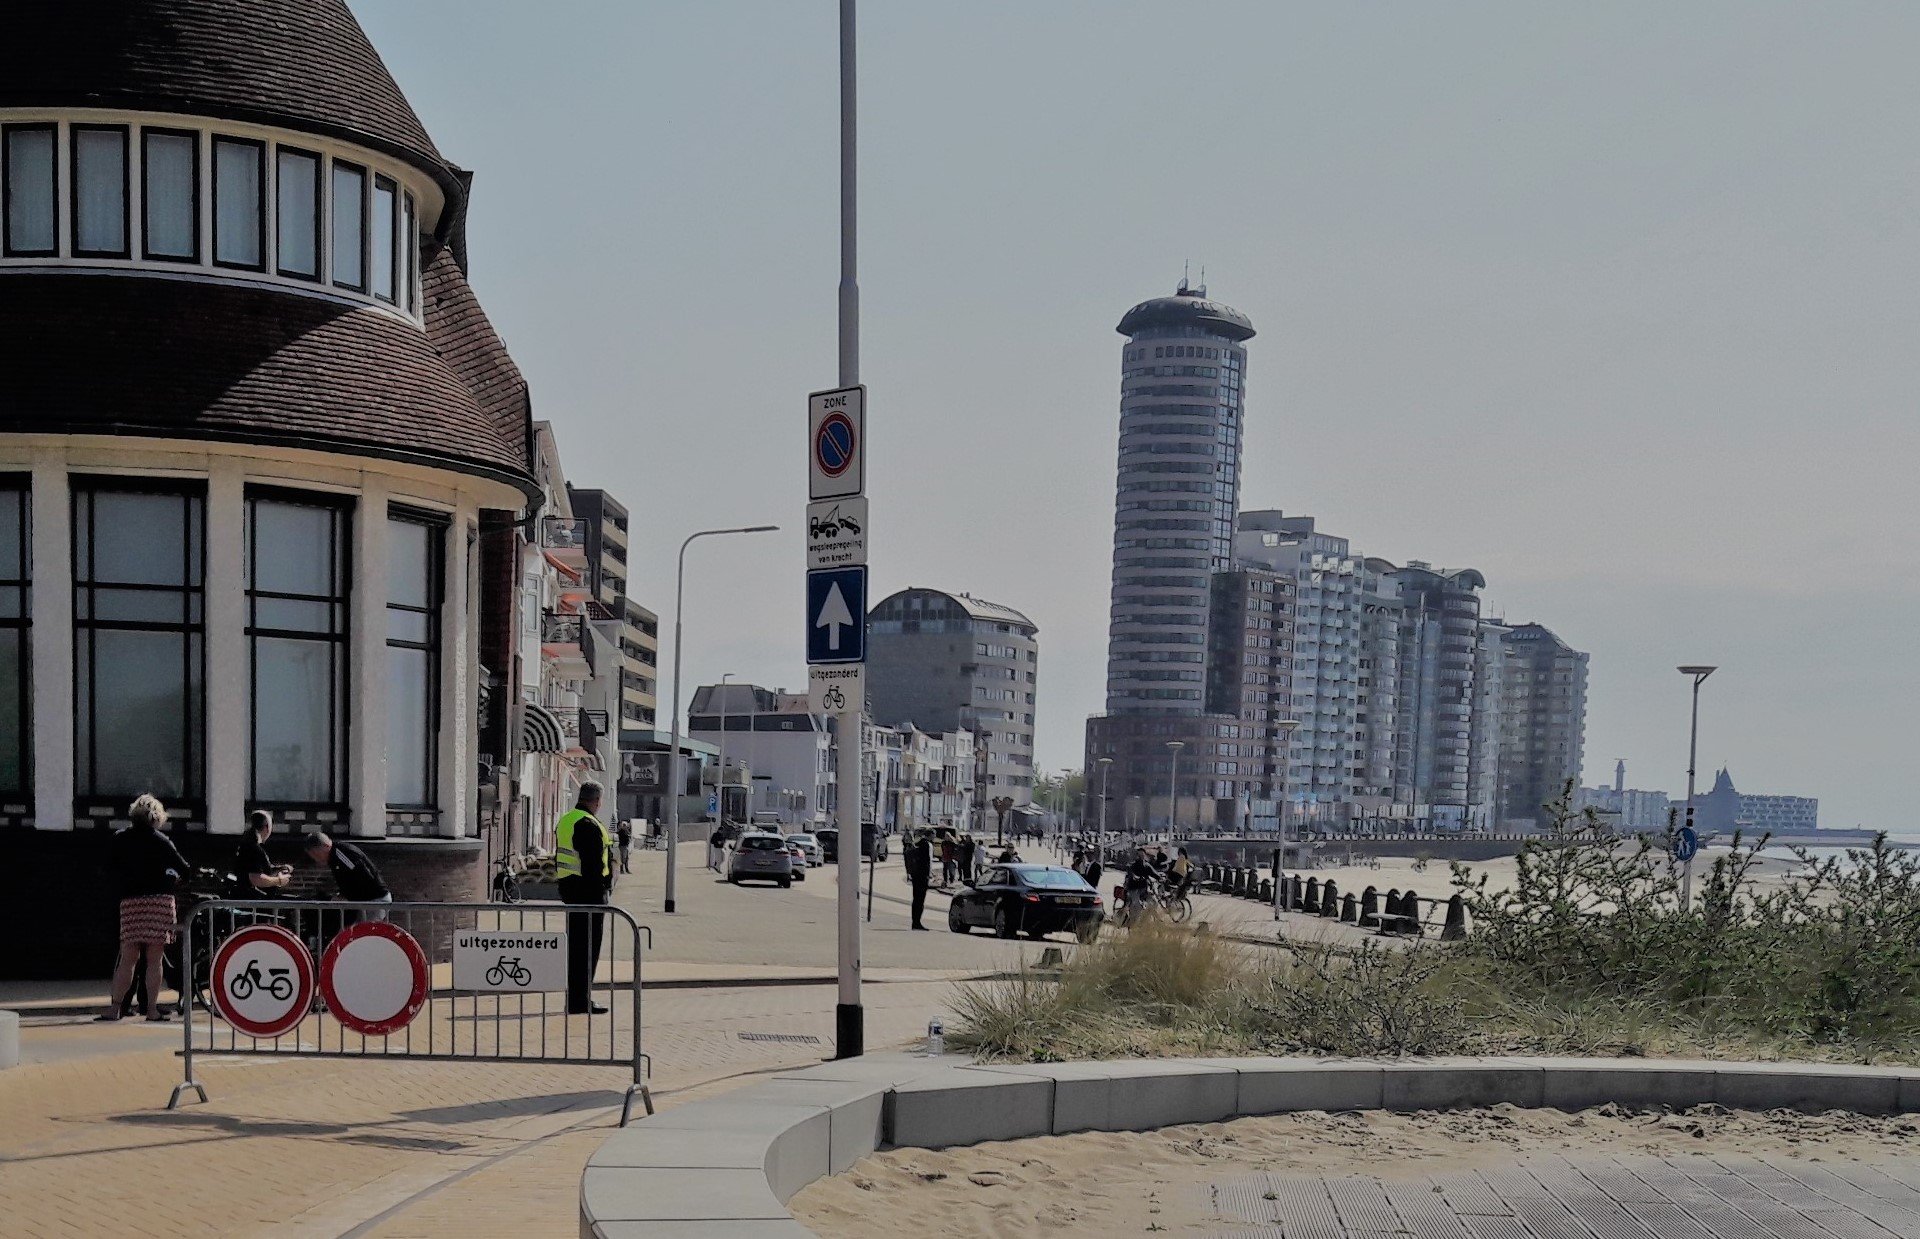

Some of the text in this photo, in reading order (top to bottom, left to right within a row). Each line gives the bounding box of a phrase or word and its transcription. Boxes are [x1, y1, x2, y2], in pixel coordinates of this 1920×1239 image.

[823, 395, 847, 409] ZONE
[810, 668, 858, 681] uitgezonderd
[460, 936, 558, 952] uitgezonderd
